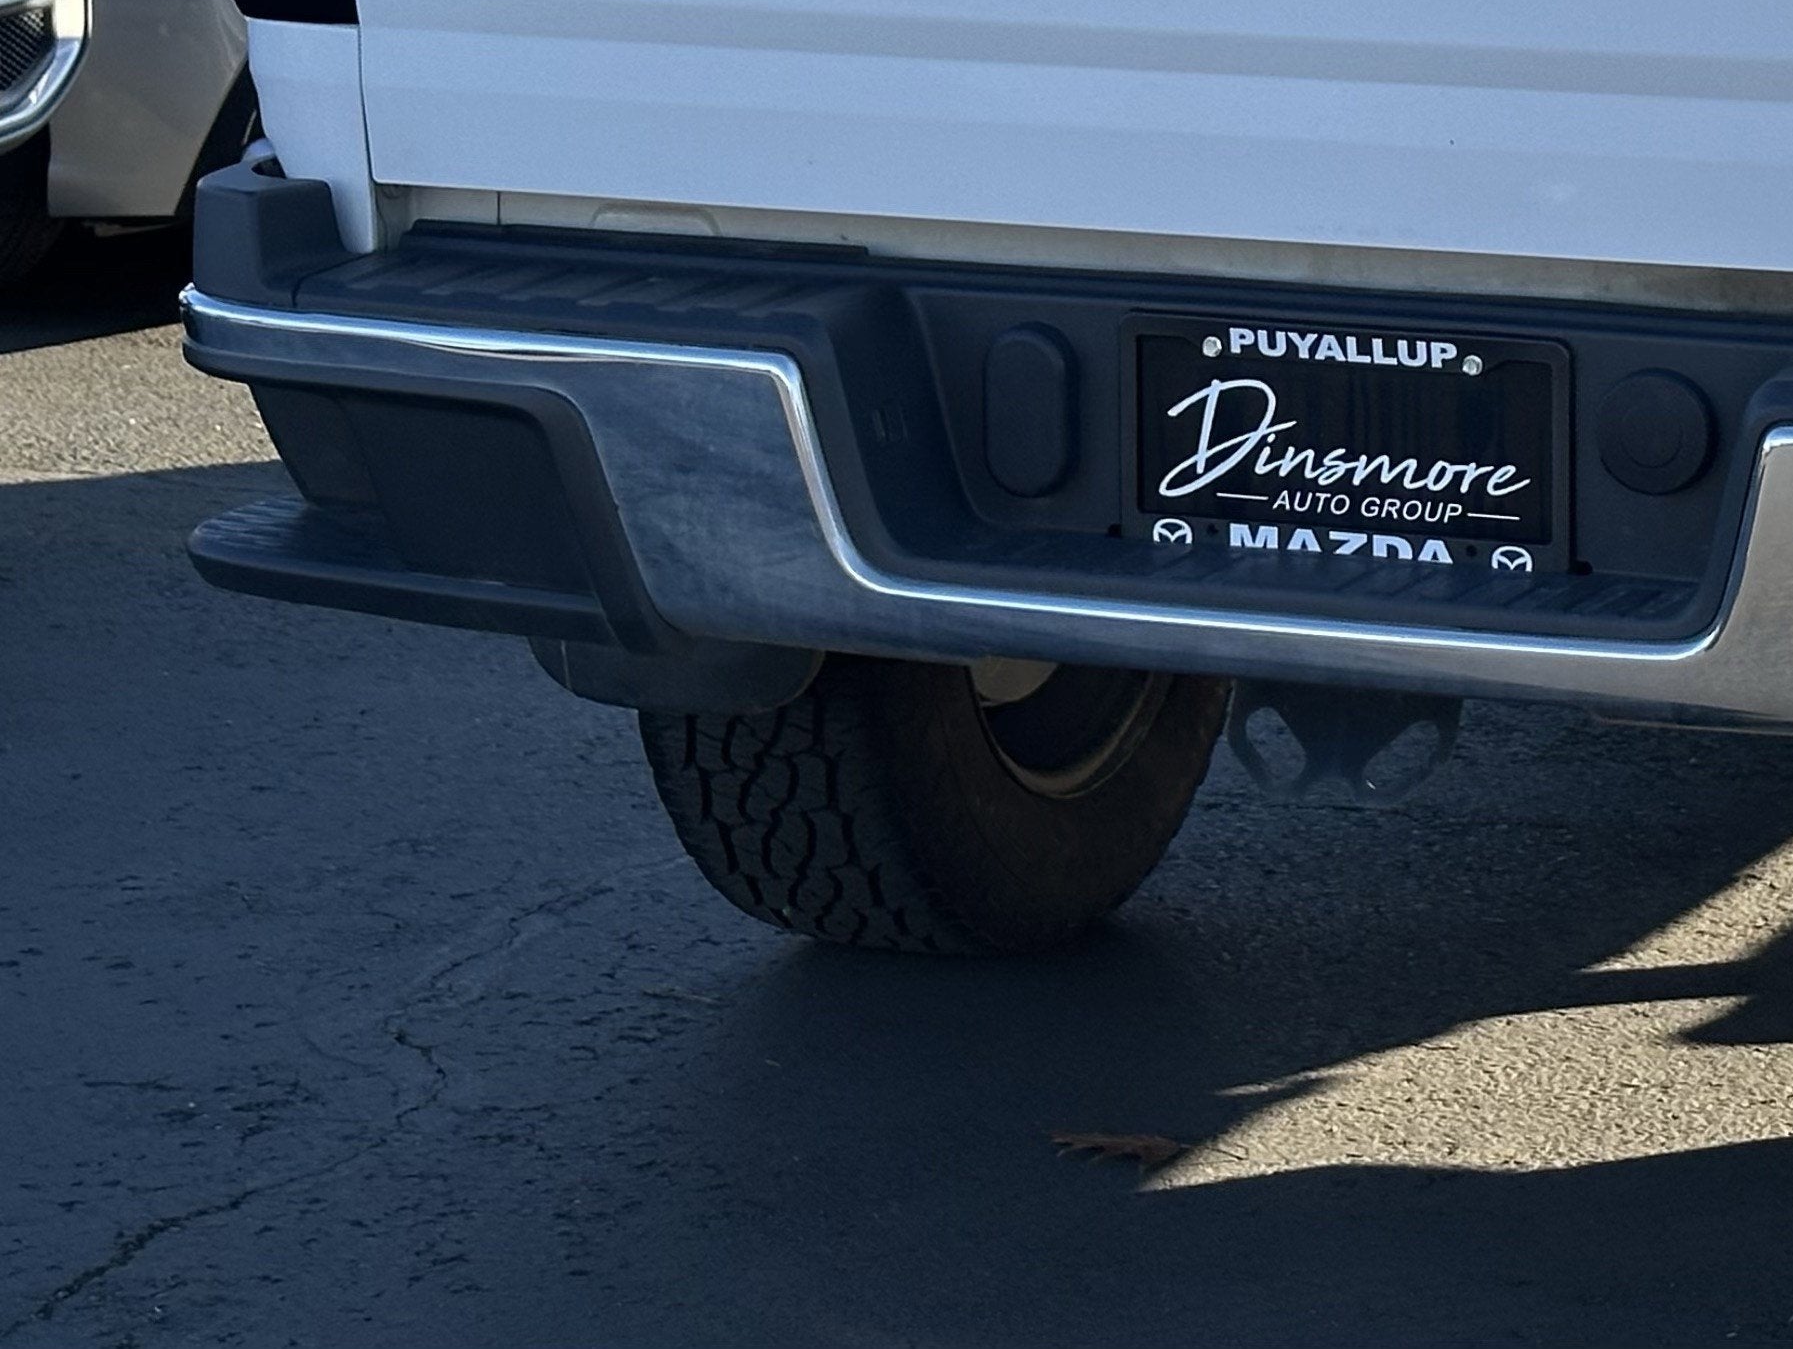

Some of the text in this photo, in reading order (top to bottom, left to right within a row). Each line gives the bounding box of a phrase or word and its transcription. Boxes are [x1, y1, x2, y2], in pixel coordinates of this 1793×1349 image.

[1228, 327, 1457, 368] PUYALLUP
[1158, 378, 1531, 498] Dinsmore
[1273, 489, 1463, 524] AUTO GROUP
[1229, 522, 1454, 565] MAZDA
